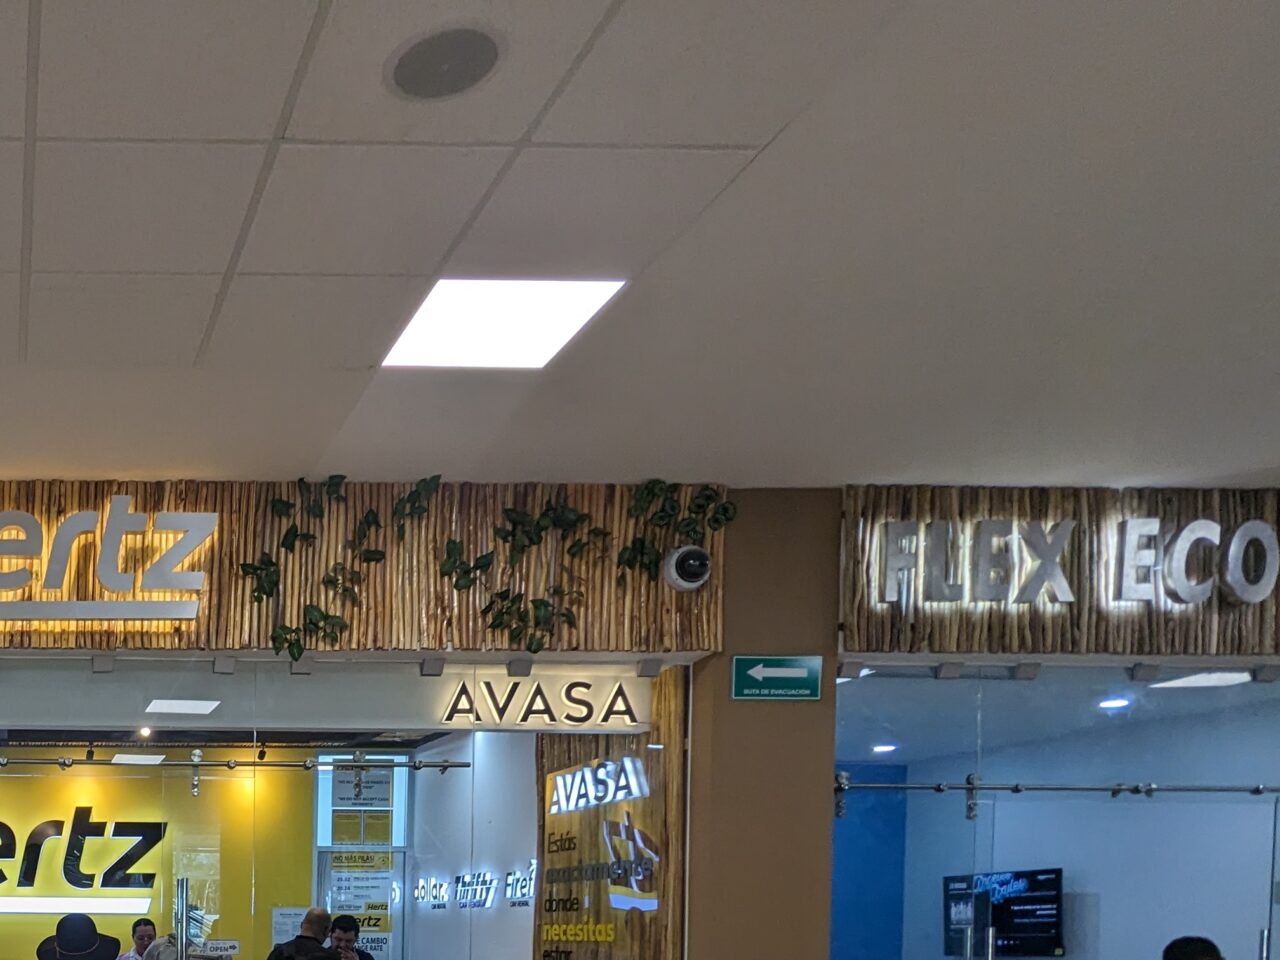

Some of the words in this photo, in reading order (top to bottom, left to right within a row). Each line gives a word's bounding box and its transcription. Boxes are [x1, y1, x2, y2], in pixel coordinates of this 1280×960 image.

[880, 517, 1076, 603] FLEX
[1113, 517, 1280, 604] ECO
[443, 680, 638, 724] AVASA
[549, 757, 649, 814] AVASA
[547, 831, 577, 854] Estás
[367, 903, 388, 911] Hertz
[544, 890, 579, 913] donde
[356, 916, 381, 928] ertz
[543, 915, 615, 942] necesitas
[209, 945, 229, 953] OPEN
[361, 937, 388, 945] CAMBIO
